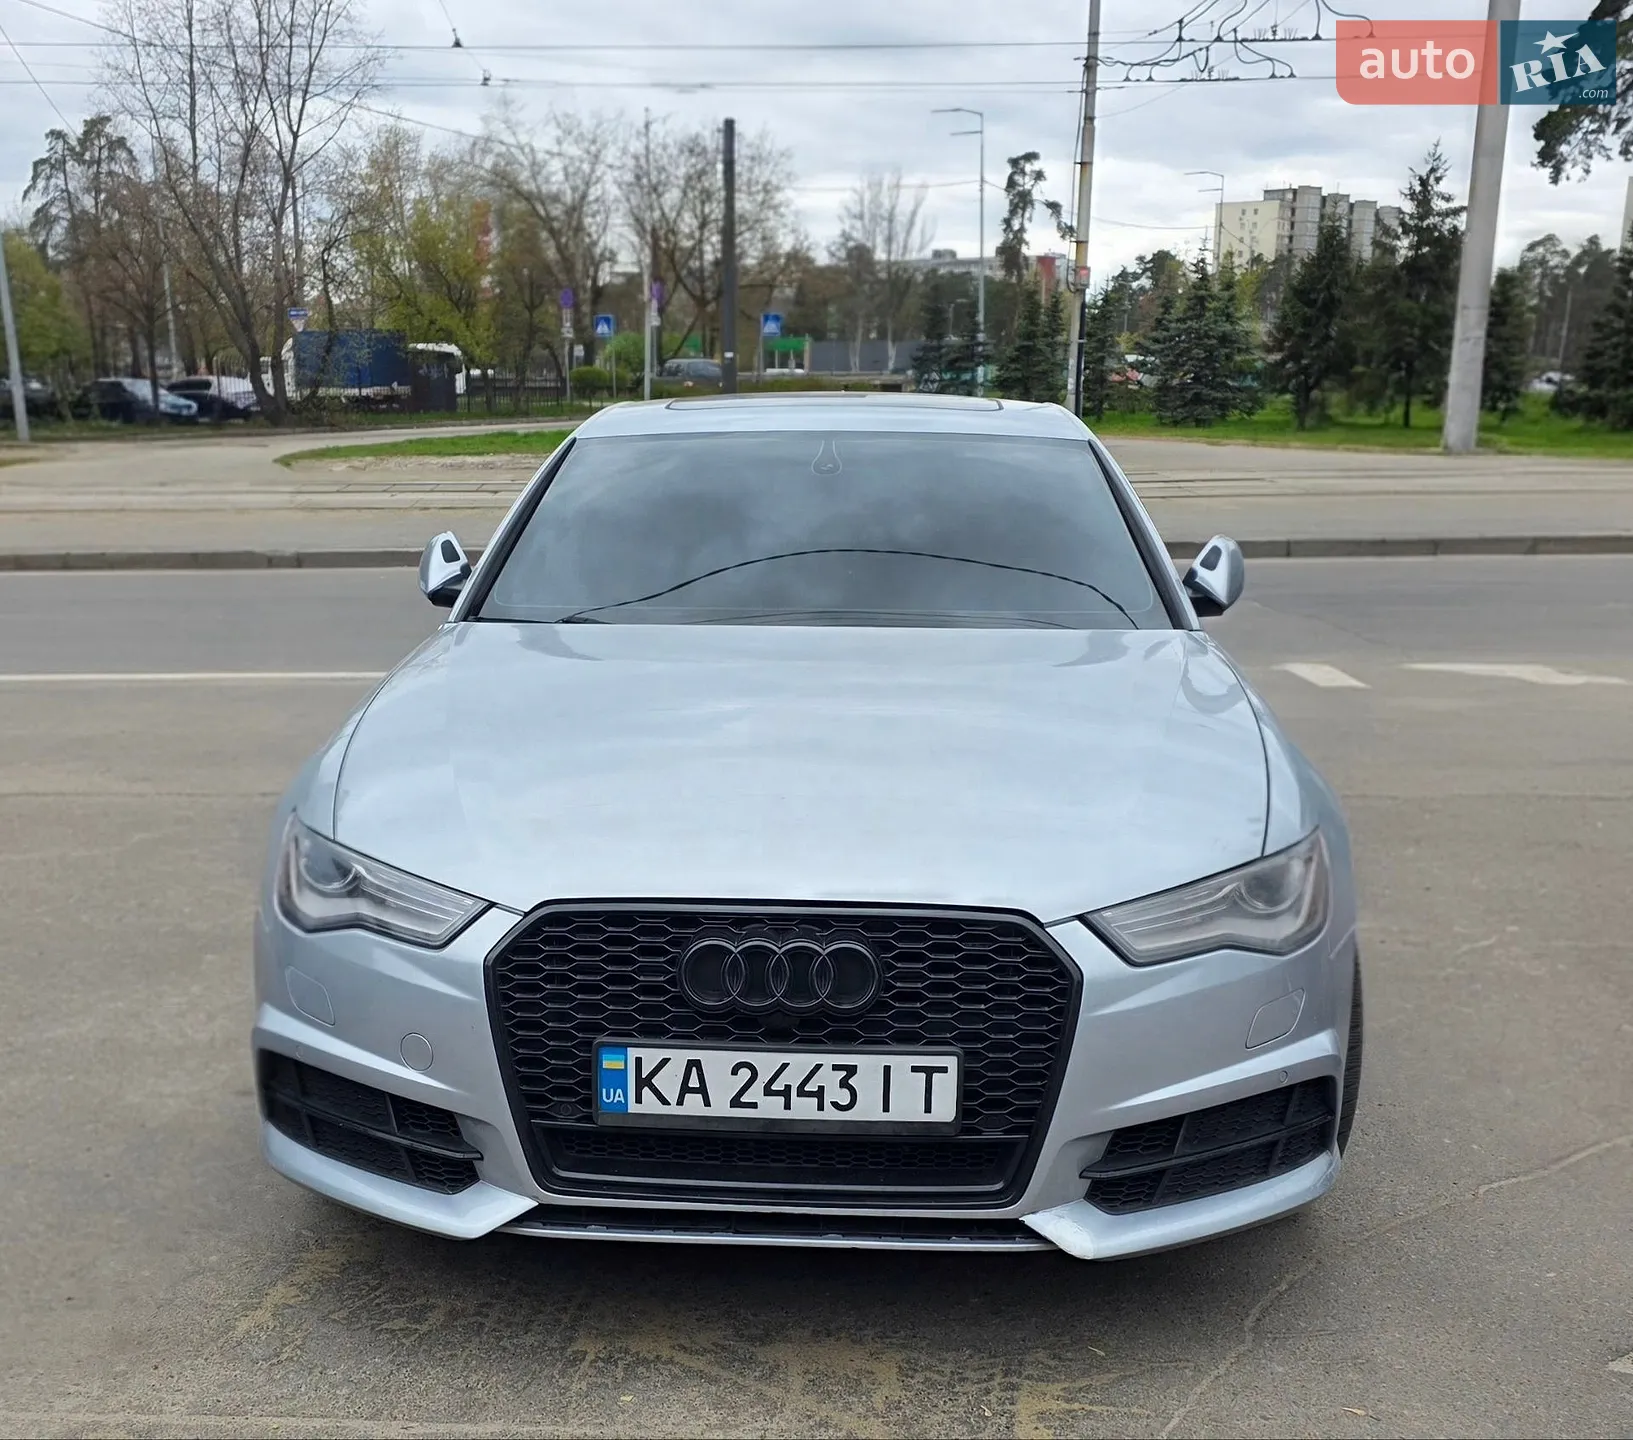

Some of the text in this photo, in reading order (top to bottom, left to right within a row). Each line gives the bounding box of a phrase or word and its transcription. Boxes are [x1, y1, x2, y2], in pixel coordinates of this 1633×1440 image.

[602, 1088, 625, 1104] UA
[634, 1056, 712, 1107] KA
[729, 1060, 858, 1112] 2443
